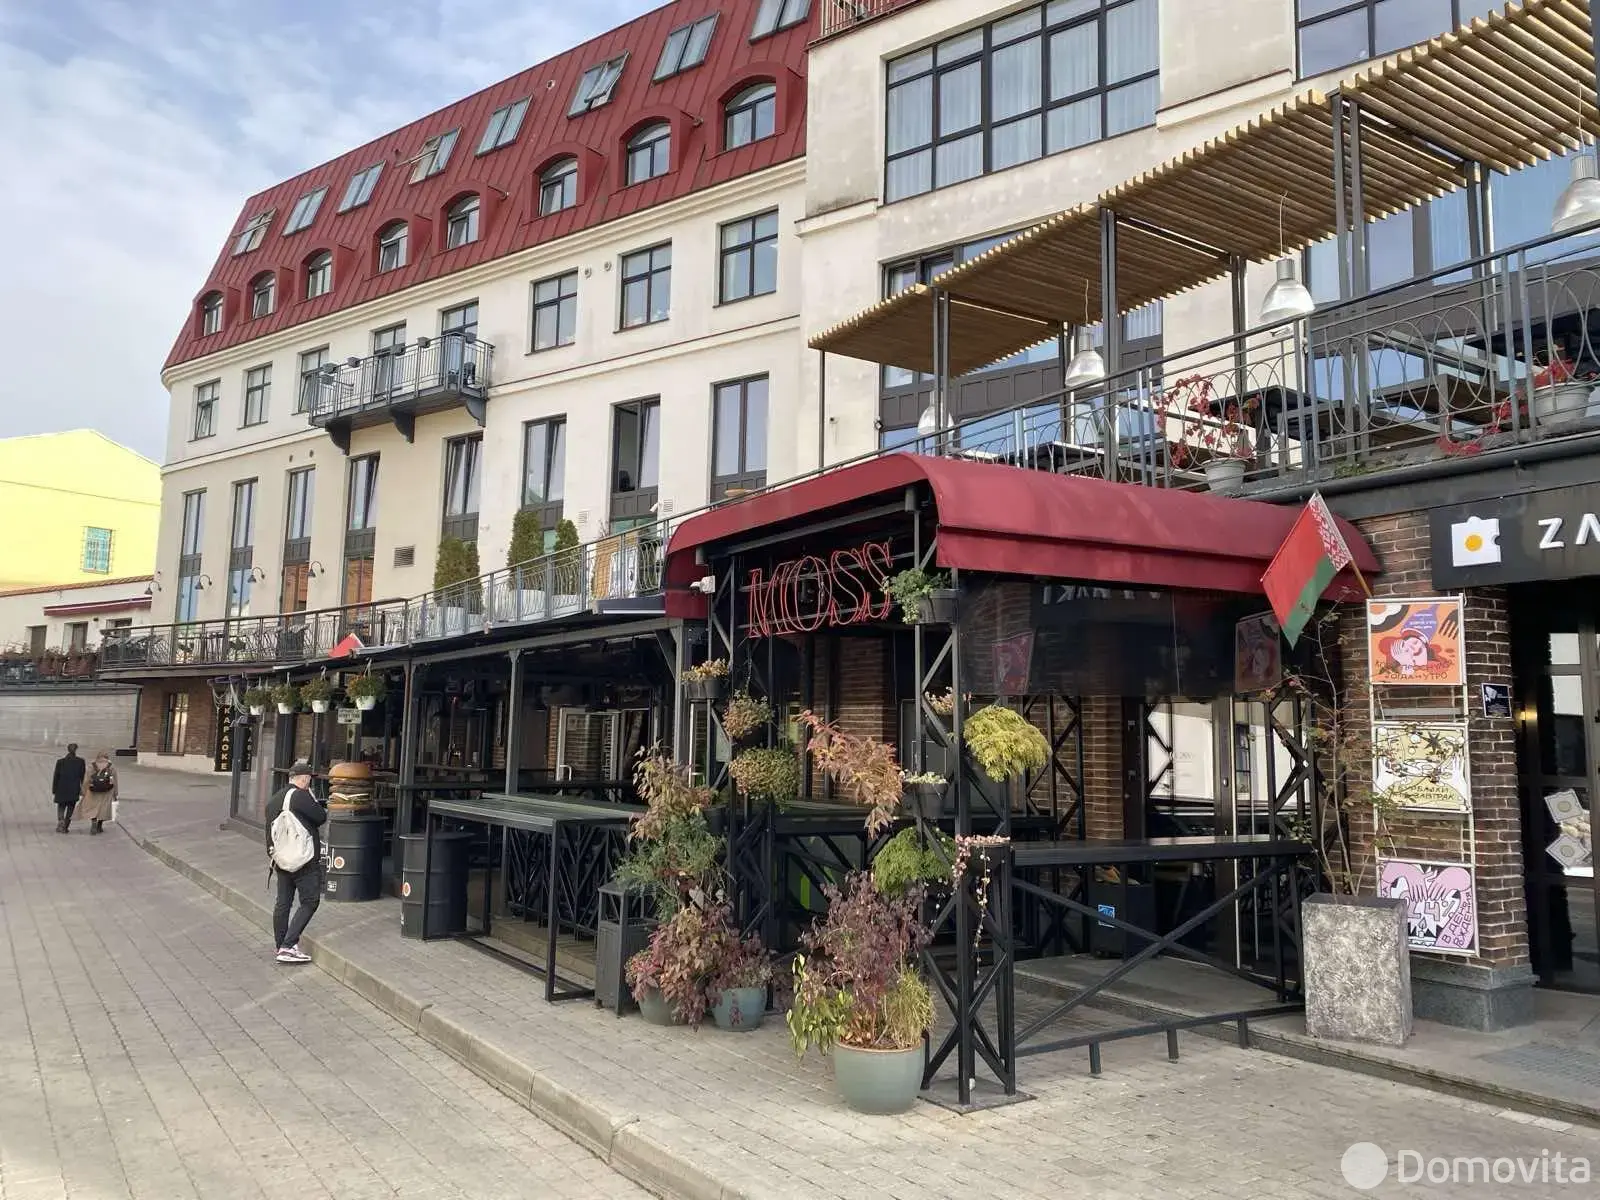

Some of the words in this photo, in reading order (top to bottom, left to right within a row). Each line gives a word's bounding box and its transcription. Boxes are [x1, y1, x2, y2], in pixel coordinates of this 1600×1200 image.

[747, 540, 893, 638] MOSS
[1423, 672, 1448, 680] УТРО
[220, 707, 231, 770] КАРАОКЕ
[1441, 934, 1452, 944] В
